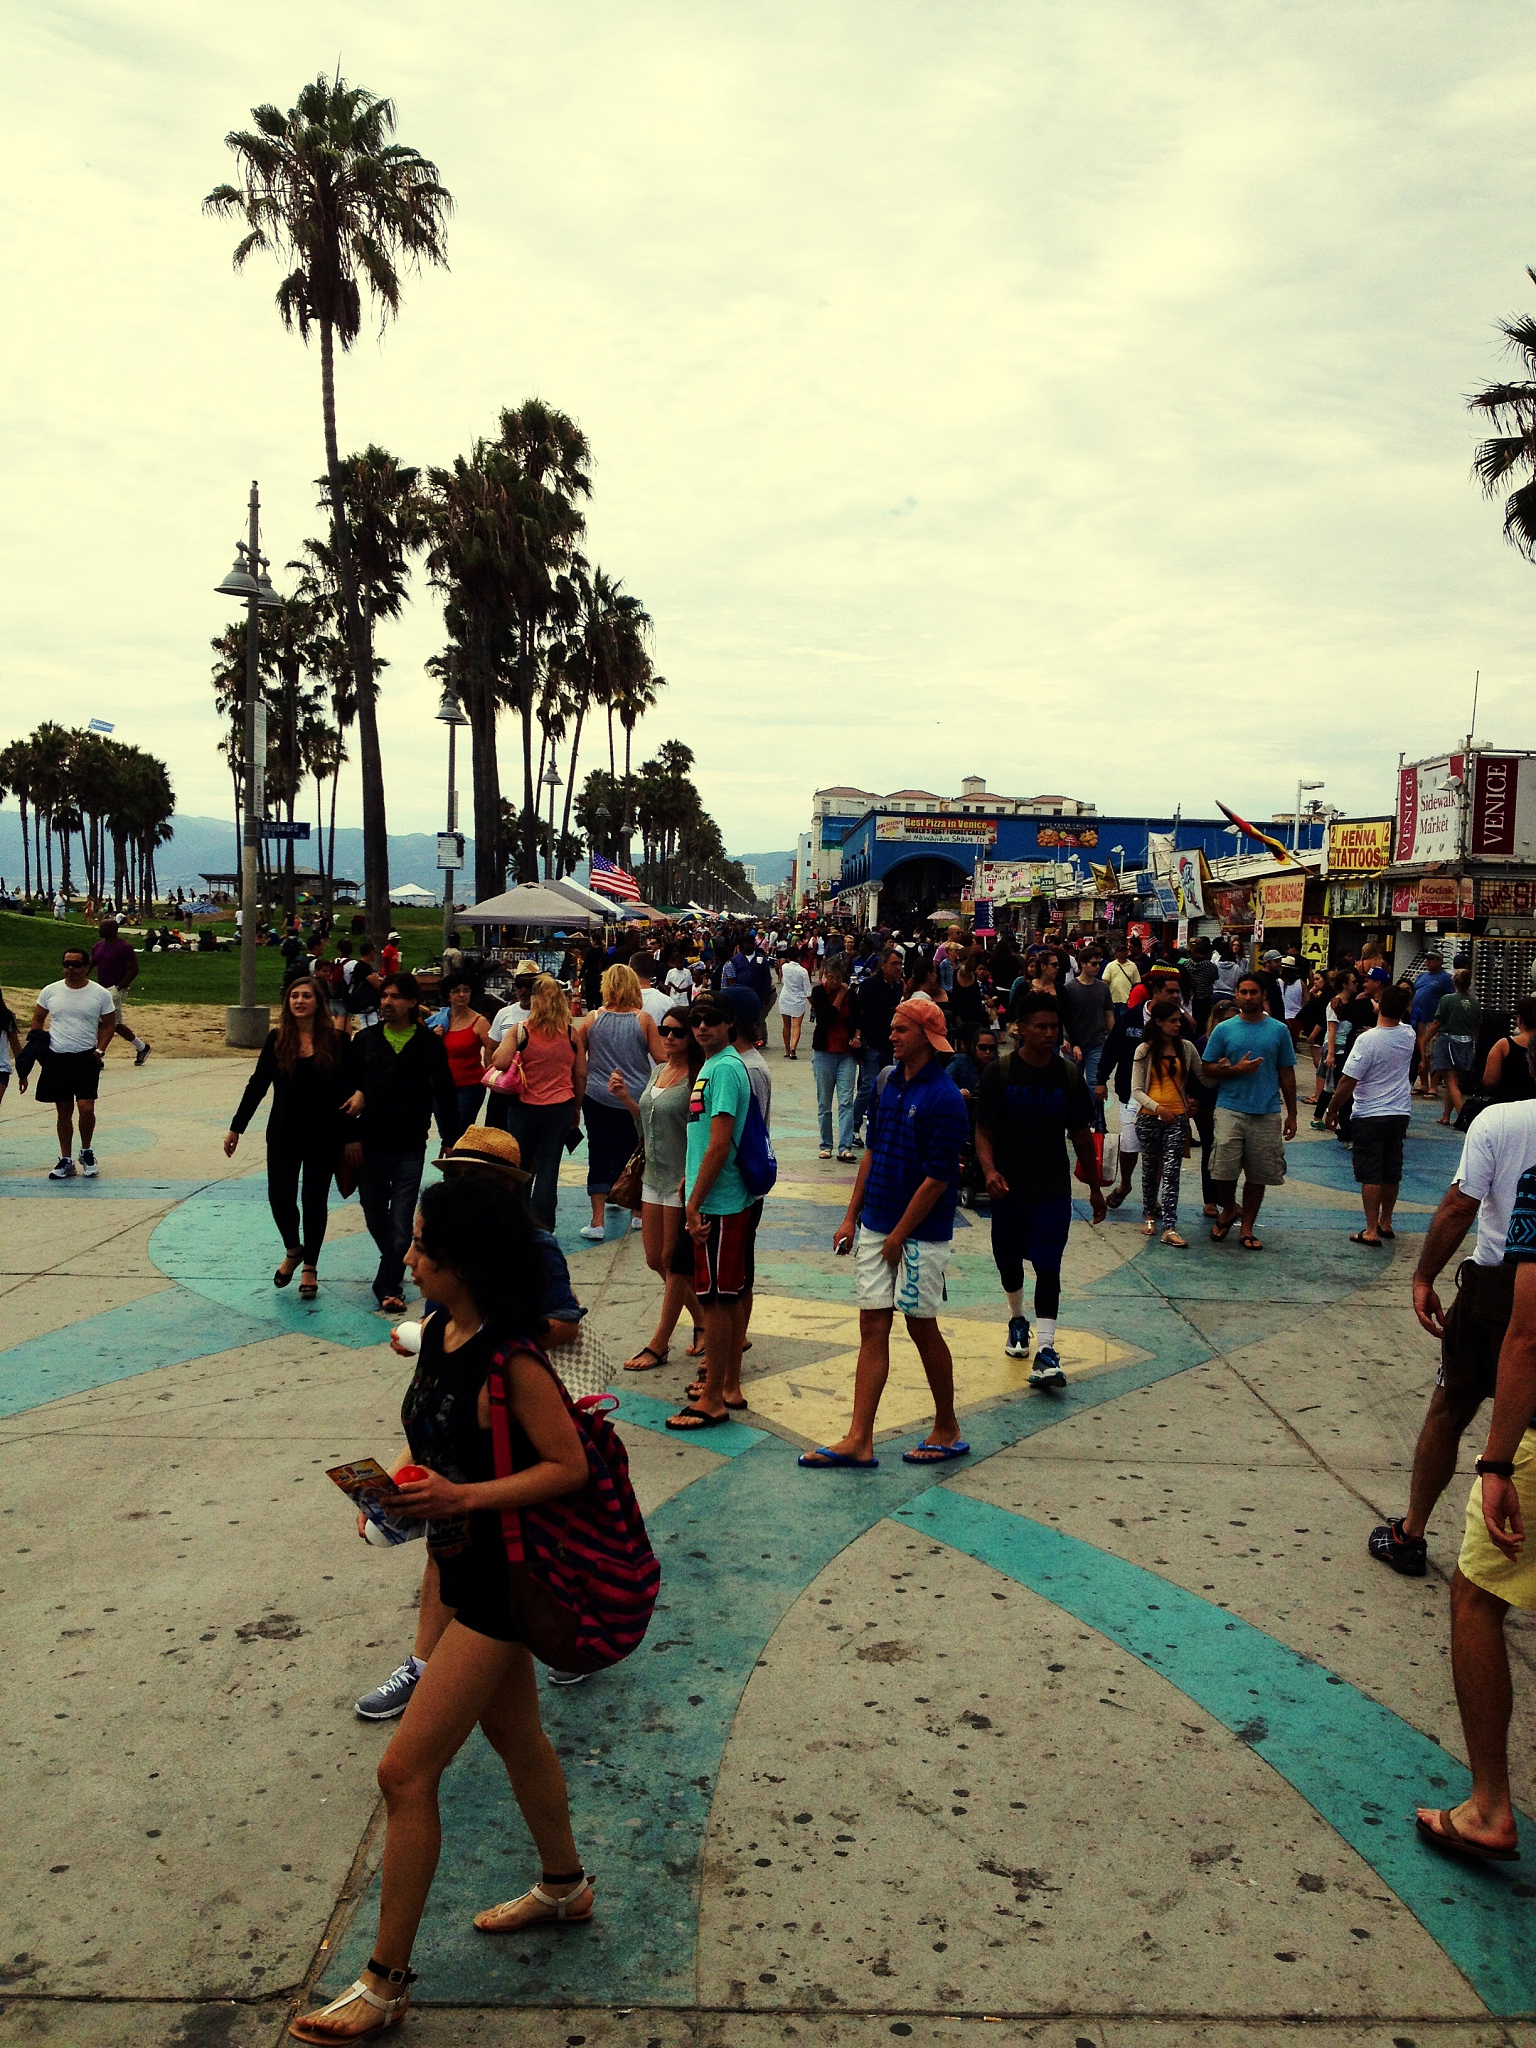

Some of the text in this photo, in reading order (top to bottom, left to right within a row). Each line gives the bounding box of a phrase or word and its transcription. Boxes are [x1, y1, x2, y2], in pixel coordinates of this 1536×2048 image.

[1420, 790, 1456, 812] Sidewalk
[1483, 764, 1507, 846] VENICE
[1401, 772, 1413, 854] VENICE
[262, 824, 299, 832] Windward
[905, 818, 987, 829] Best Pizza in Venice
[1420, 817, 1449, 835] Market
[1331, 826, 1336, 843] 2
[1341, 829, 1377, 846] HENNA
[1384, 823, 1390, 842] 2
[1335, 847, 1381, 868] TATTOOS
[1041, 879, 1055, 887] ATM
[1421, 885, 1454, 895] Kodak
